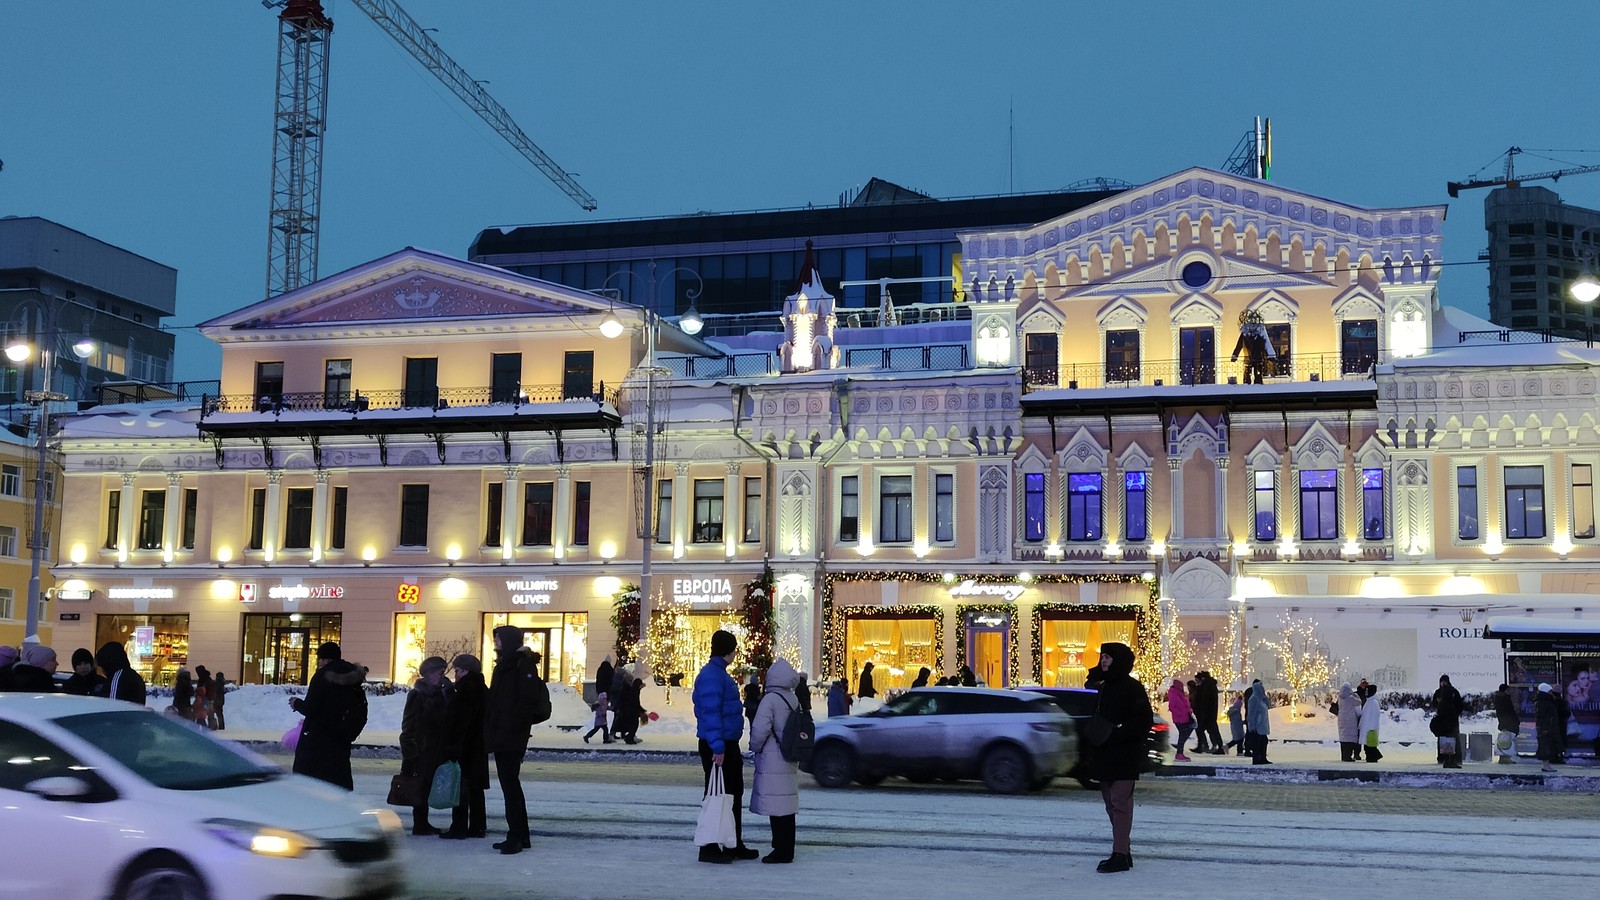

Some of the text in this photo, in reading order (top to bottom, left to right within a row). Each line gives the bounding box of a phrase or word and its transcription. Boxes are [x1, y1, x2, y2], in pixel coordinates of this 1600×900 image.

[506, 580, 559, 591] WILLIAMS
[673, 579, 732, 594] ЕВРОПА
[949, 579, 1025, 601] Mercury
[511, 594, 551, 605] OLIVER
[710, 594, 733, 604] ЦЕНТР
[1439, 627, 1484, 639] ROLE
